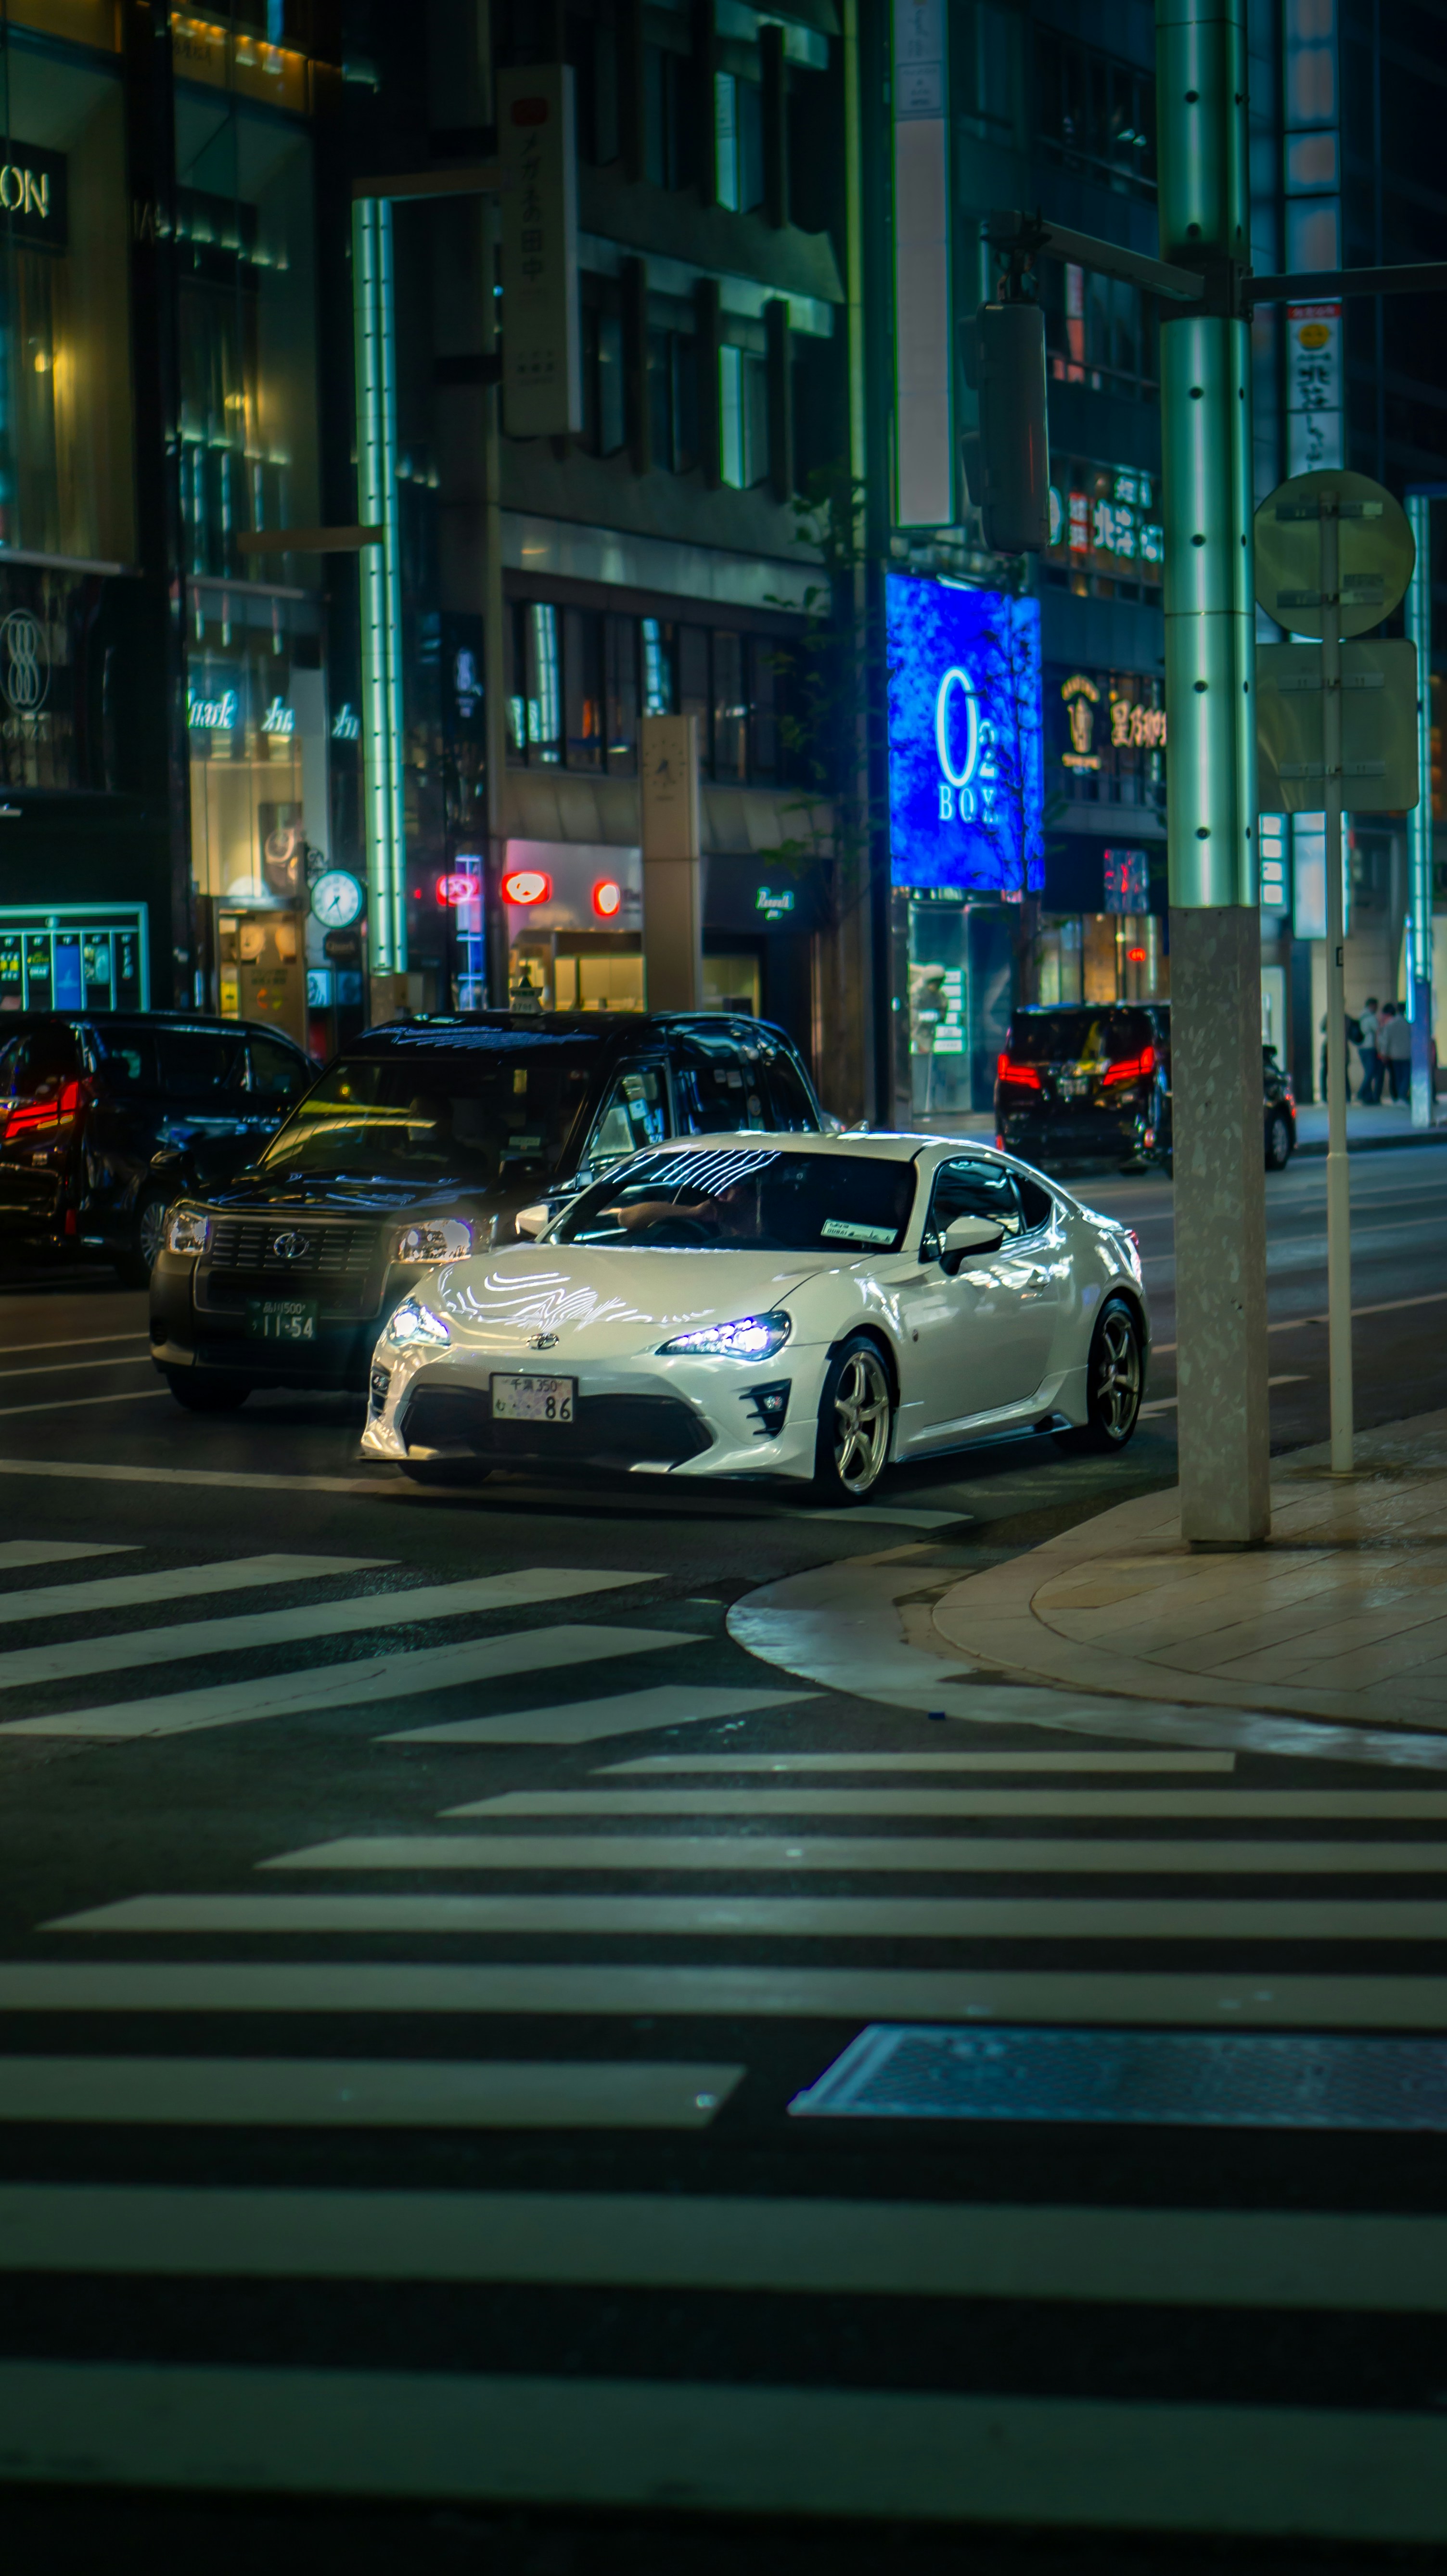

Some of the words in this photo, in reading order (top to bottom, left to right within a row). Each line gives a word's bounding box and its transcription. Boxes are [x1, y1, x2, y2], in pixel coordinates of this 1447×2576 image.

[0, 165, 50, 219] ON
[939, 785, 998, 822] BOX
[283, 1302, 302, 1314] 500
[264, 1315, 312, 1339] 11-54
[536, 1379, 557, 1392] 350
[545, 1396, 571, 1420] 86
